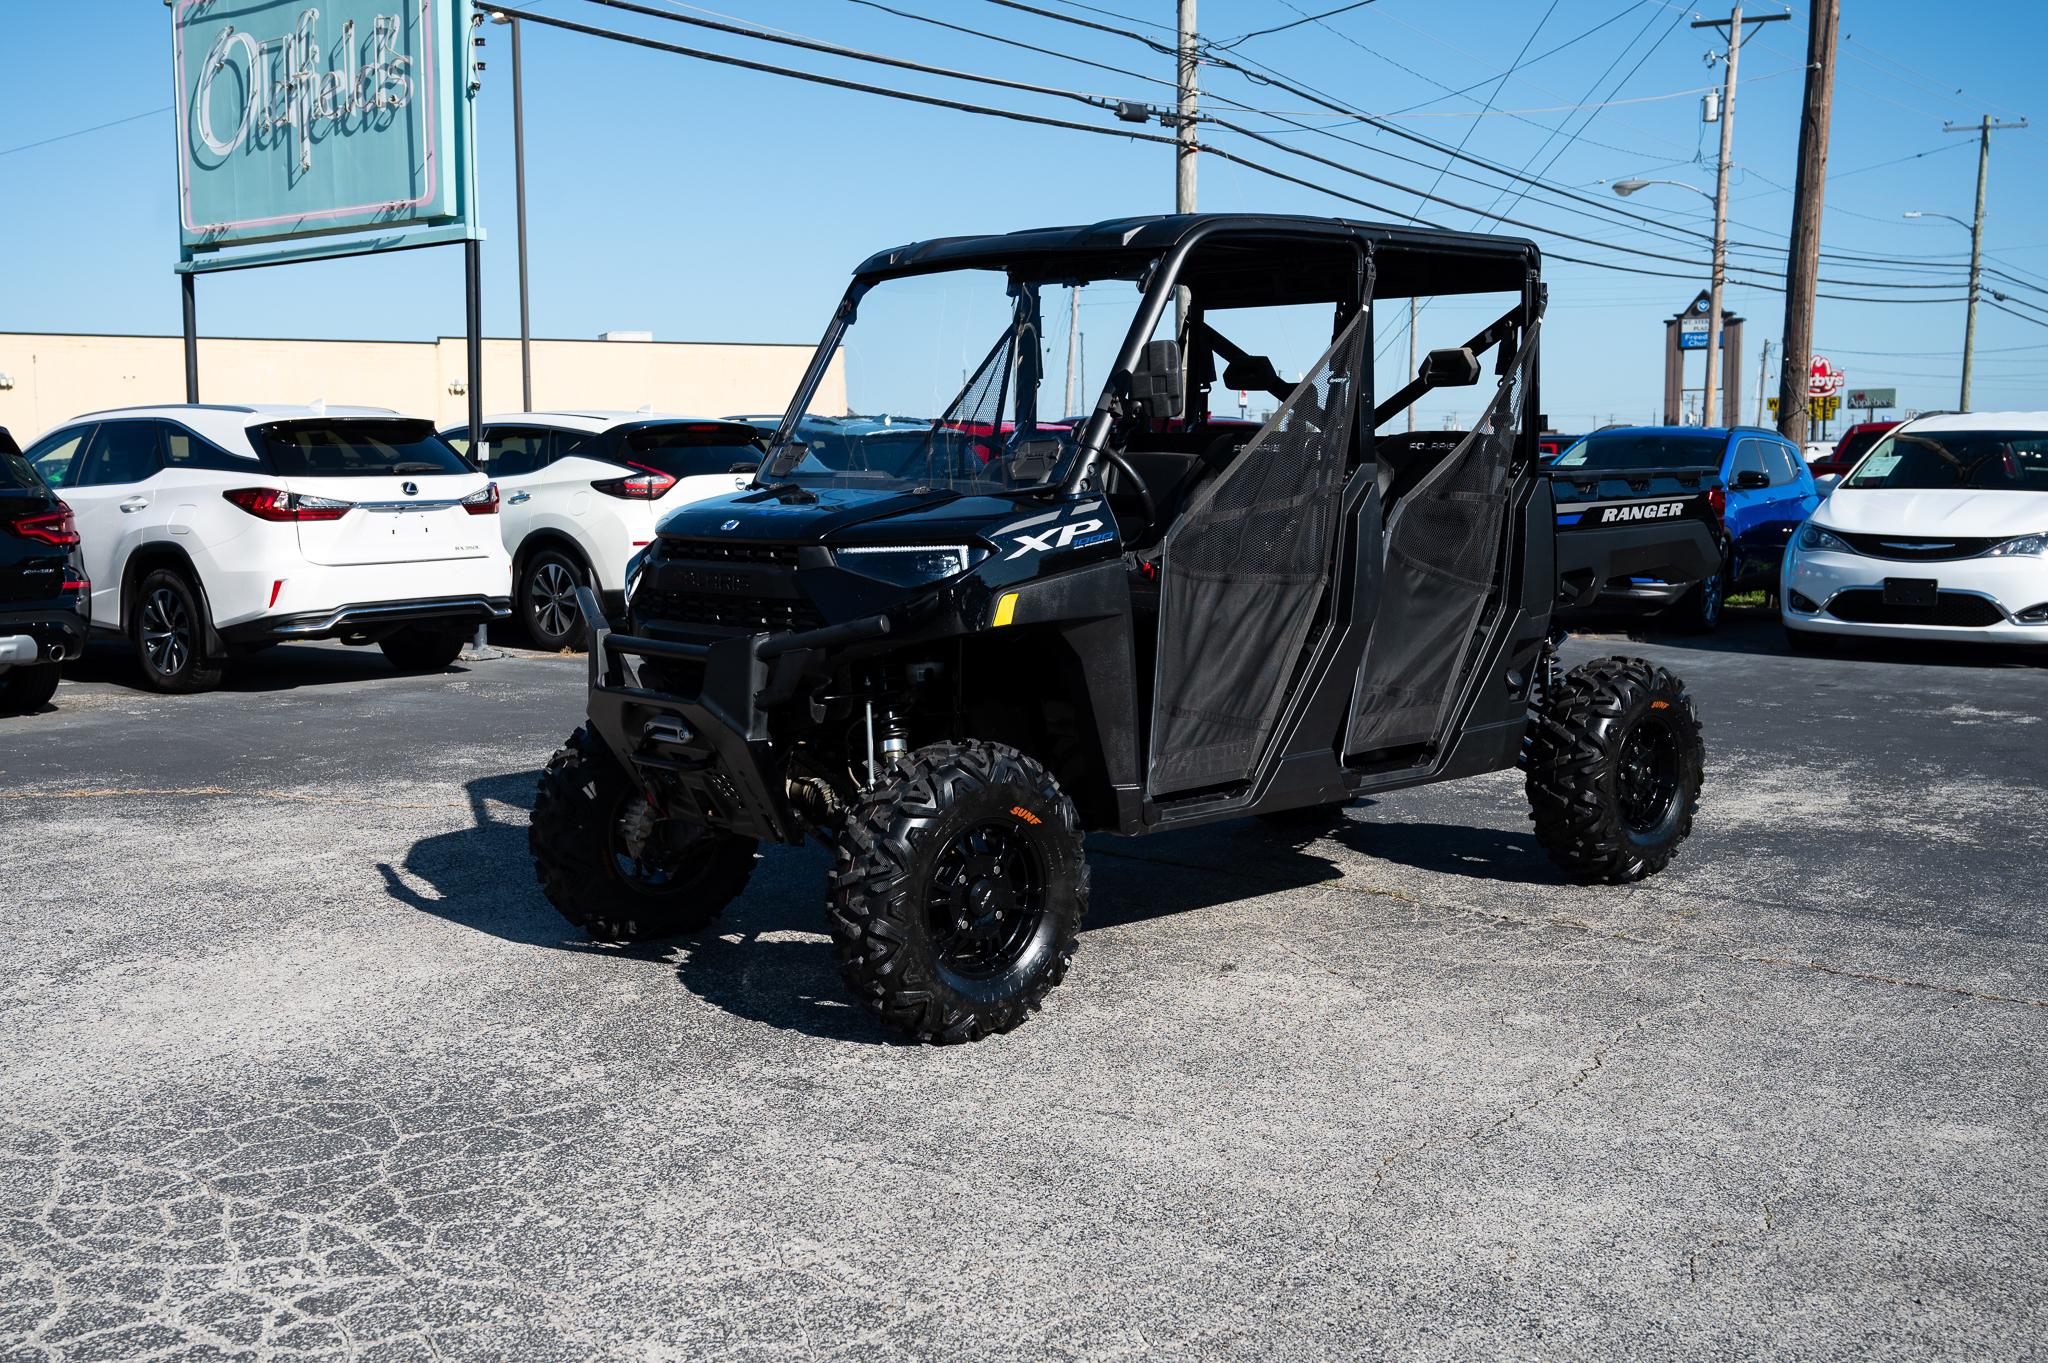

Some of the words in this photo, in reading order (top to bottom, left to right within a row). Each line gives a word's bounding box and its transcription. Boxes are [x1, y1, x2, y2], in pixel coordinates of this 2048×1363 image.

[1808, 373, 1844, 390] rby's
[1601, 502, 1684, 523] RANGER
[1003, 518, 1104, 561] XP
[1073, 531, 1114, 547] 1000
